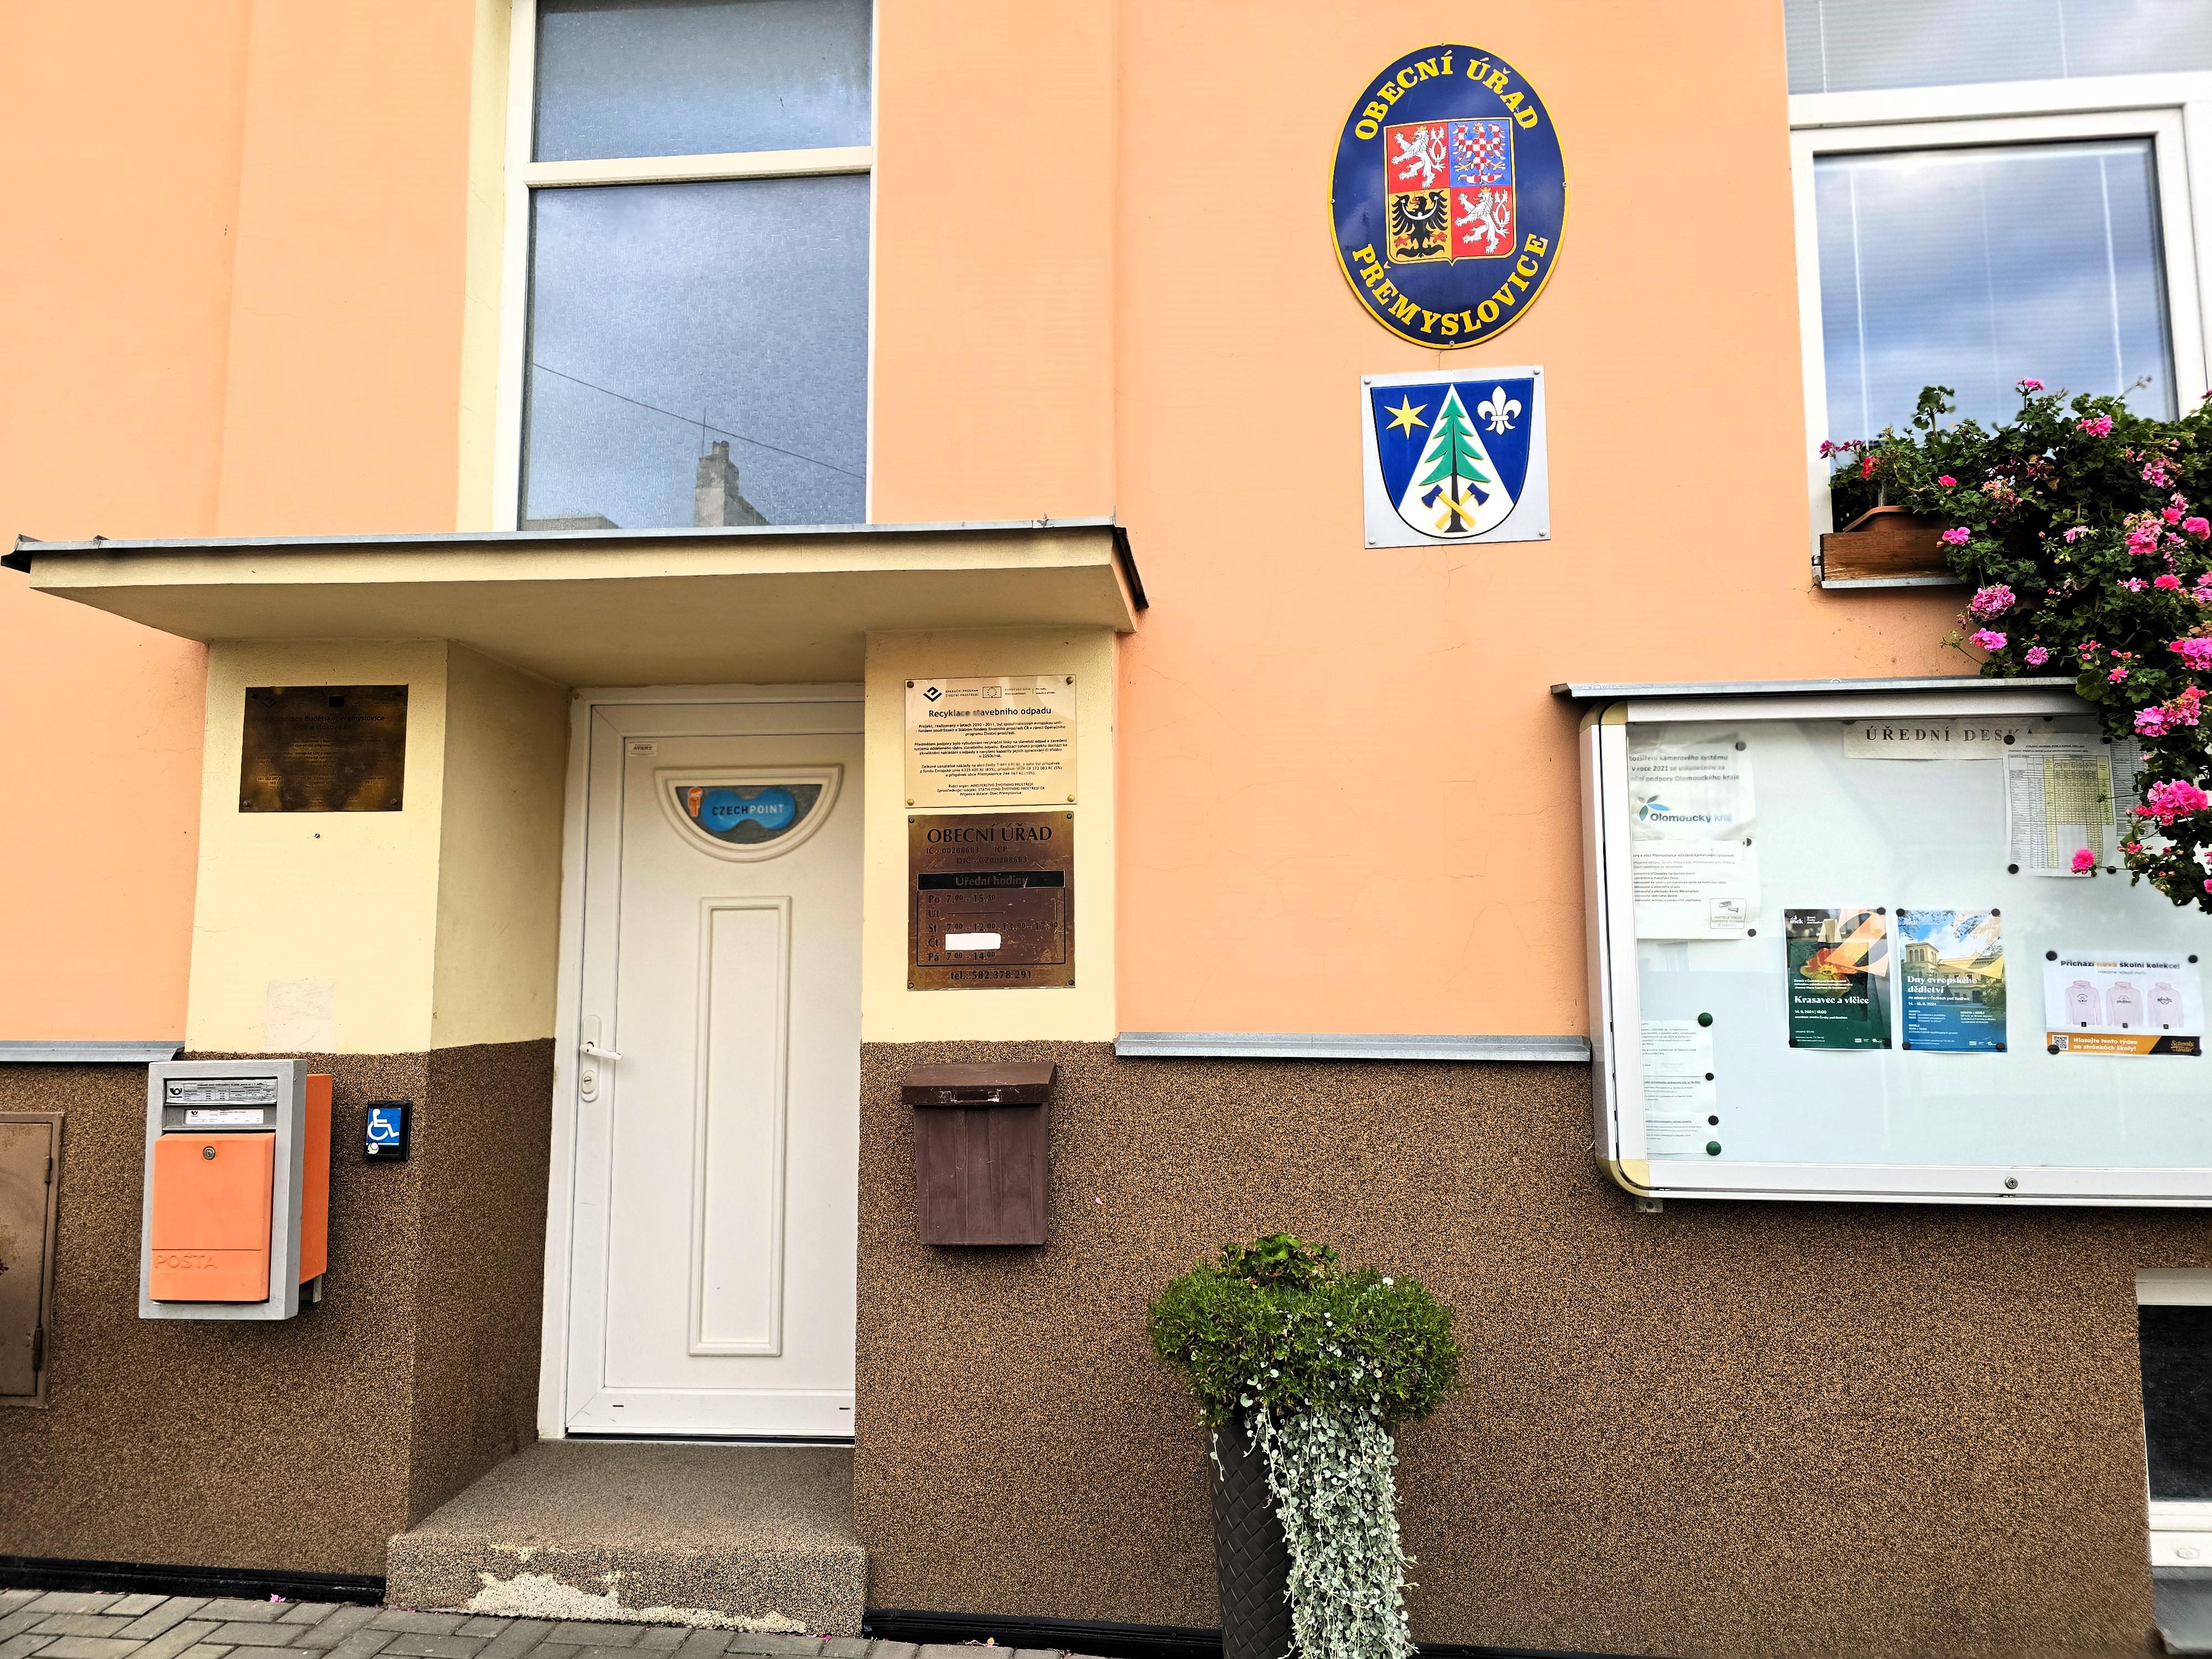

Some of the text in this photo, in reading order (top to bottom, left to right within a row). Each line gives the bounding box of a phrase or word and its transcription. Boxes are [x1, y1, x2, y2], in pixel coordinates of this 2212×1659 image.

[1354, 50, 1539, 140] OBECNÍ ÚŘAD
[1353, 233, 1548, 336] PŘEMYSLOVICE
[929, 709, 970, 718] Recyklace
[1021, 707, 1051, 716] odpadu
[1865, 725, 2033, 741] ÚŘEDNÍ DES
[712, 804, 784, 816] CZECHPOINT
[1650, 813, 1712, 823] Olomoucký
[927, 822, 1052, 843] OBECNÍ ÚŘAD
[956, 875, 1026, 885] Úřední hodiny
[928, 895, 940, 904] Po
[928, 907, 940, 918] Út
[928, 924, 937, 932] St
[928, 936, 938, 947] Čt
[928, 952, 939, 961] Pá
[972, 971, 989, 979] 582
[994, 971, 1011, 979] 378
[1908, 975, 1978, 985] Dny evropského
[1908, 985, 1944, 994] dědictví
[1794, 995, 1835, 1004] Krasavec
